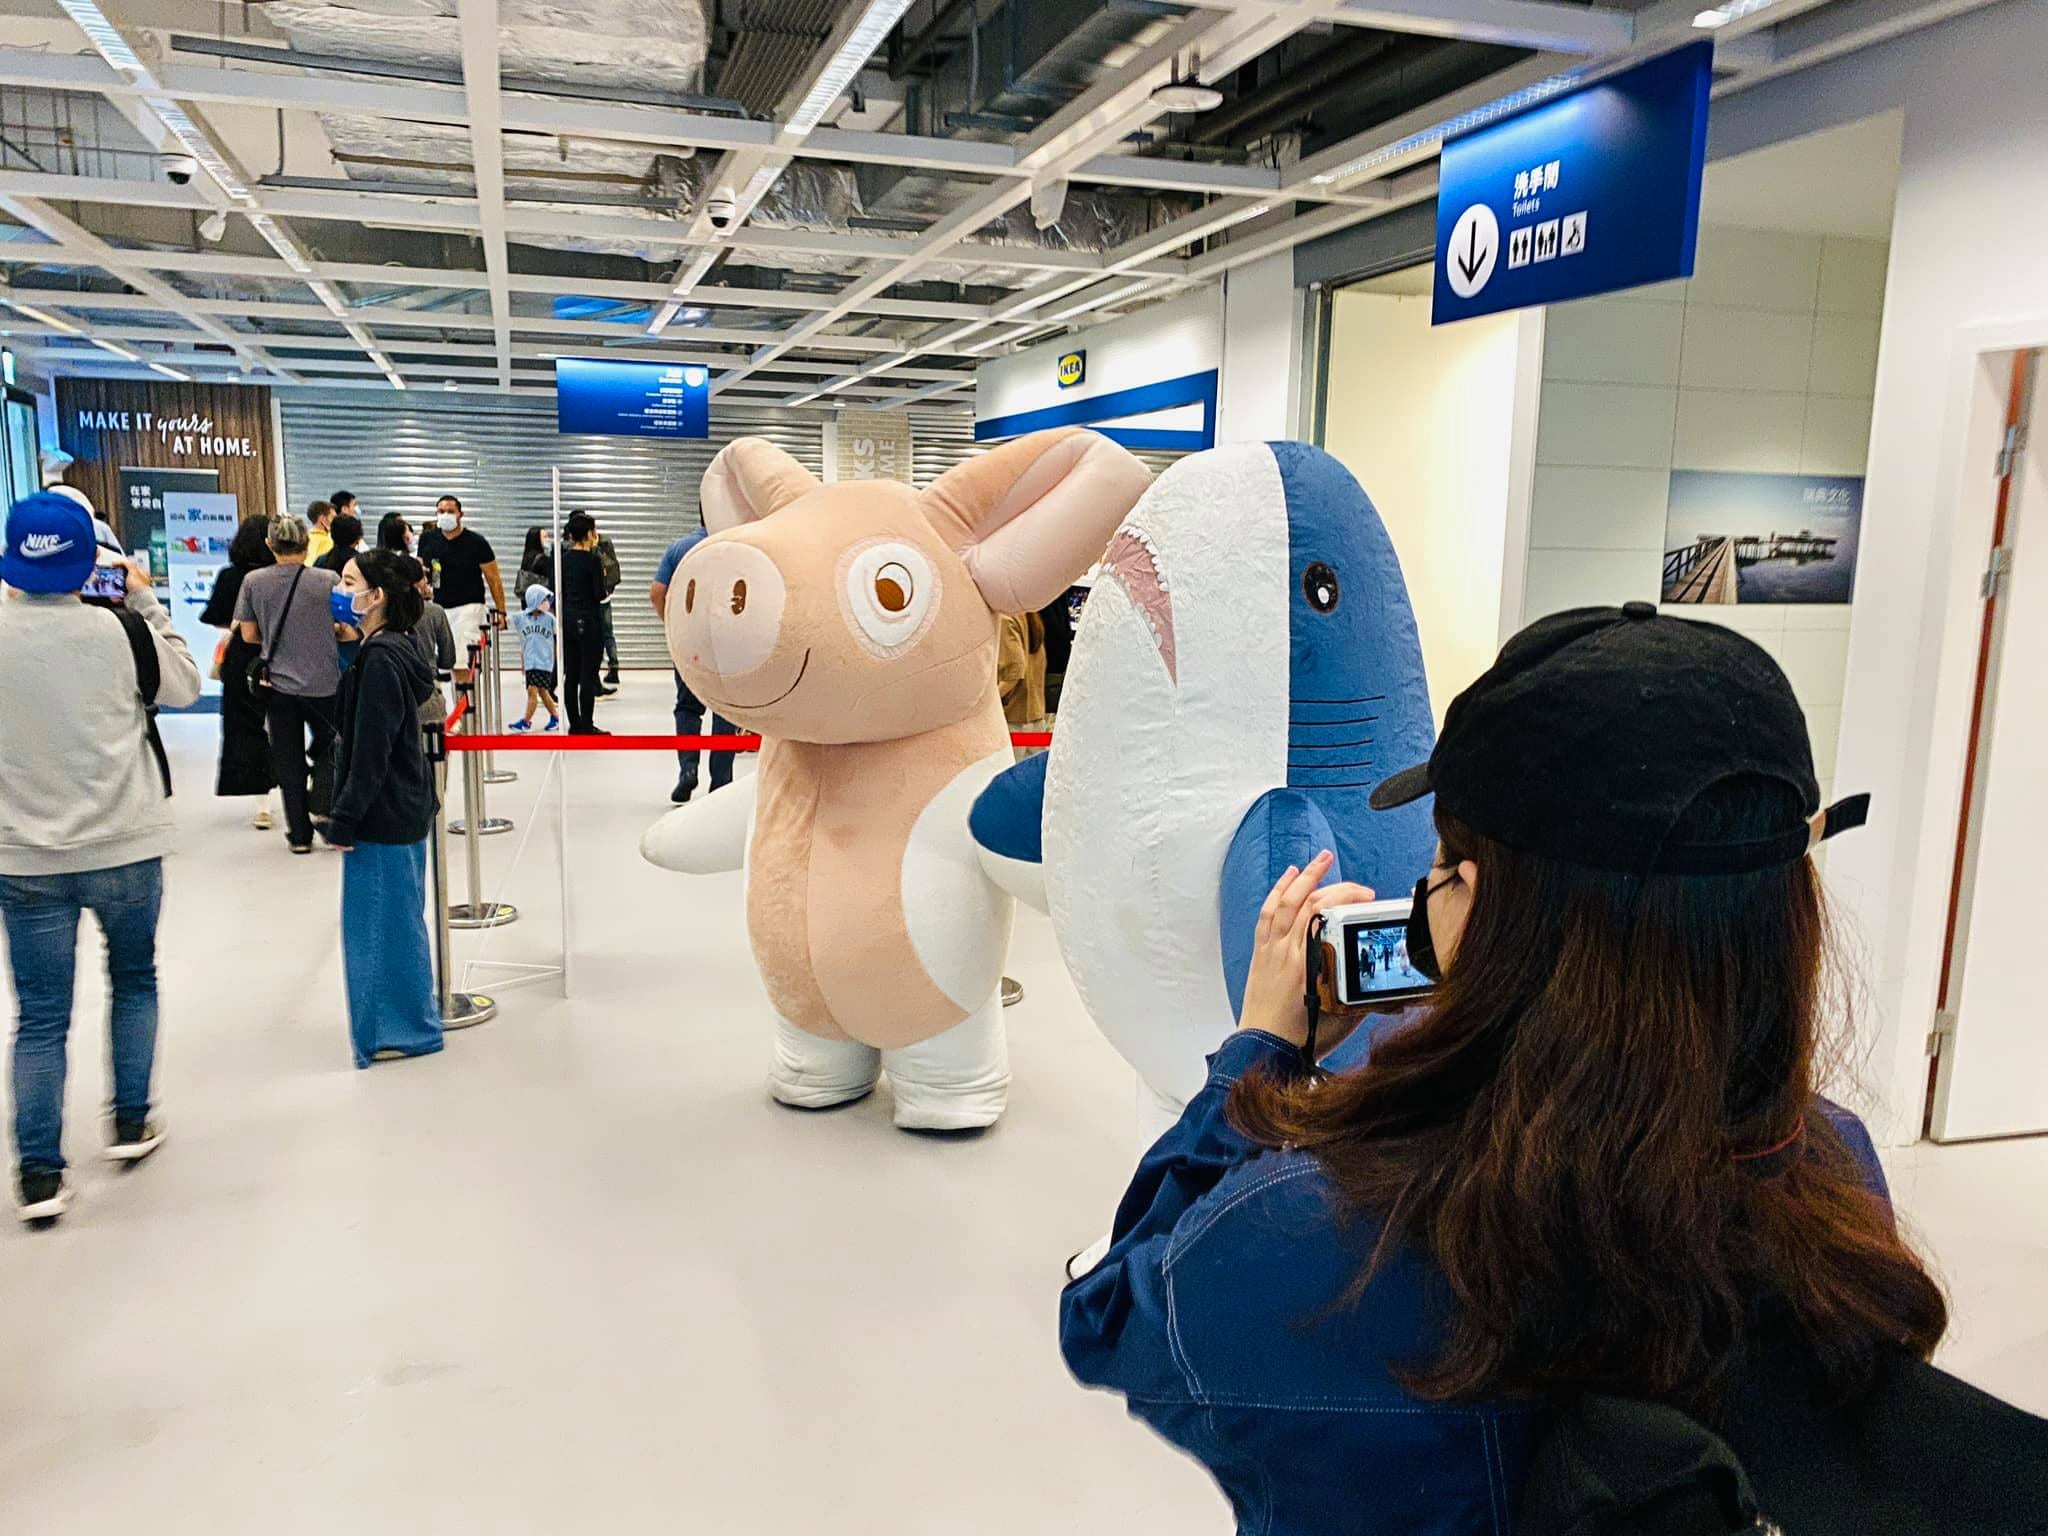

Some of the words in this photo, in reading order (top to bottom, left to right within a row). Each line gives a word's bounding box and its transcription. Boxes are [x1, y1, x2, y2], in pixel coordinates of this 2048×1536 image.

[1513, 160, 1560, 200] 洗手間
[1512, 197, 1540, 218] Toilets
[1060, 360, 1081, 376] IKEA
[79, 410, 130, 430] MAKE
[136, 412, 152, 432] IT
[157, 413, 213, 444] yours
[173, 436, 194, 455] AT
[201, 437, 257, 457] HOME.
[26, 533, 60, 549] NIKE
[522, 625, 553, 639] ADIDAS
